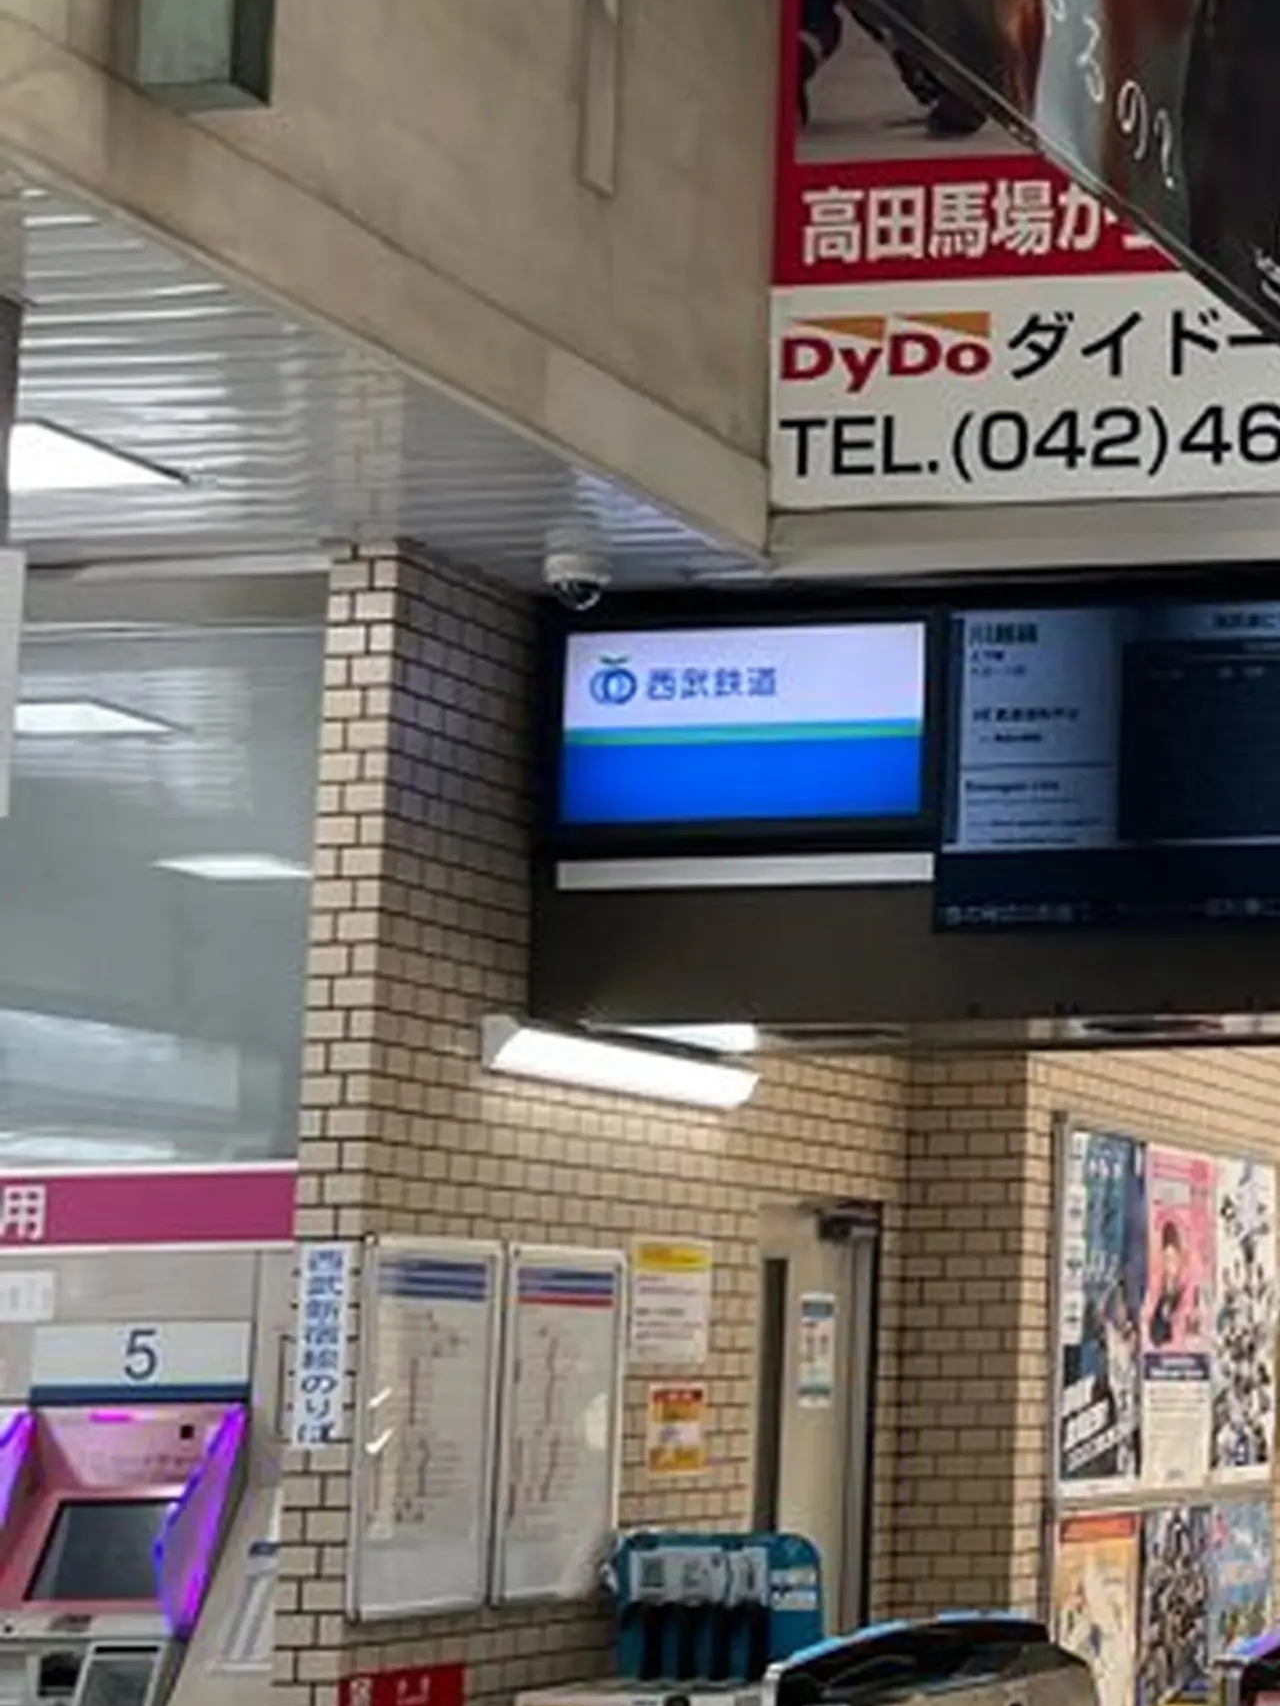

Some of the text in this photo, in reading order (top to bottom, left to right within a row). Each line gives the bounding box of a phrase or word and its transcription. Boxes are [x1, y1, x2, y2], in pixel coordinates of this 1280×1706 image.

[780, 311, 991, 394] DyDo
[645, 665, 778, 702] 西武鉄道
[123, 1327, 159, 1382] 5
[297, 1248, 345, 1445] 西武新宿線のりば
